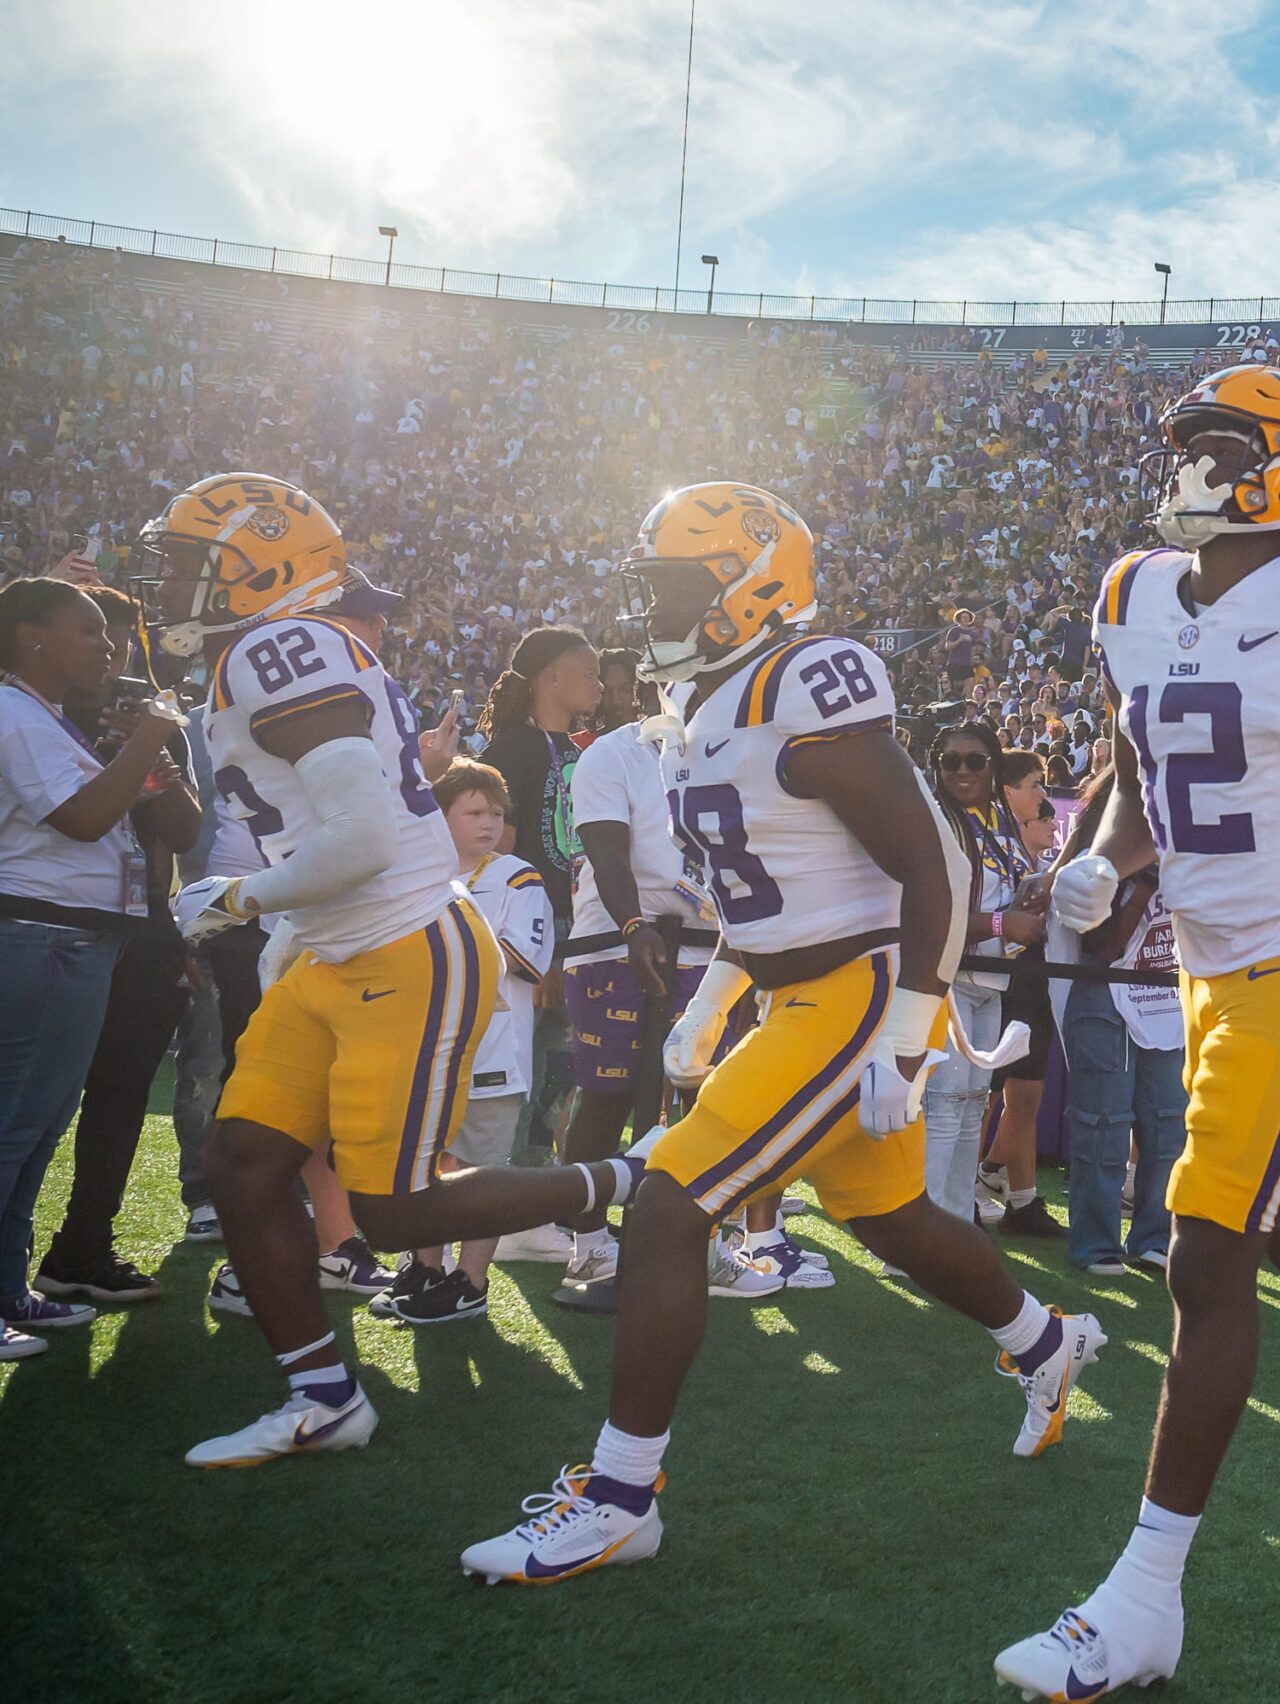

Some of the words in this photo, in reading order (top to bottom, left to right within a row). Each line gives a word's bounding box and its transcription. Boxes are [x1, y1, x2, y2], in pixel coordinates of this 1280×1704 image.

[605, 311, 650, 334] 226
[970, 328, 1007, 348] 27
[1071, 329, 1086, 338] 227
[1216, 325, 1260, 347] 228
[199, 483, 314, 517] LSU
[873, 635, 895, 650] 218
[245, 625, 327, 695] 82
[1168, 663, 1200, 677] LSU
[799, 649, 878, 720] 28
[675, 768, 690, 782] LSU
[1129, 682, 1256, 854] 12
[666, 783, 785, 925] 8
[1144, 893, 1172, 922] LS
[1142, 943, 1174, 959] BUREA
[1127, 993, 1169, 1004] September
[606, 1008, 638, 1022] LSU
[596, 1066, 630, 1079] LSU
[1074, 1334, 1087, 1361] LSU
